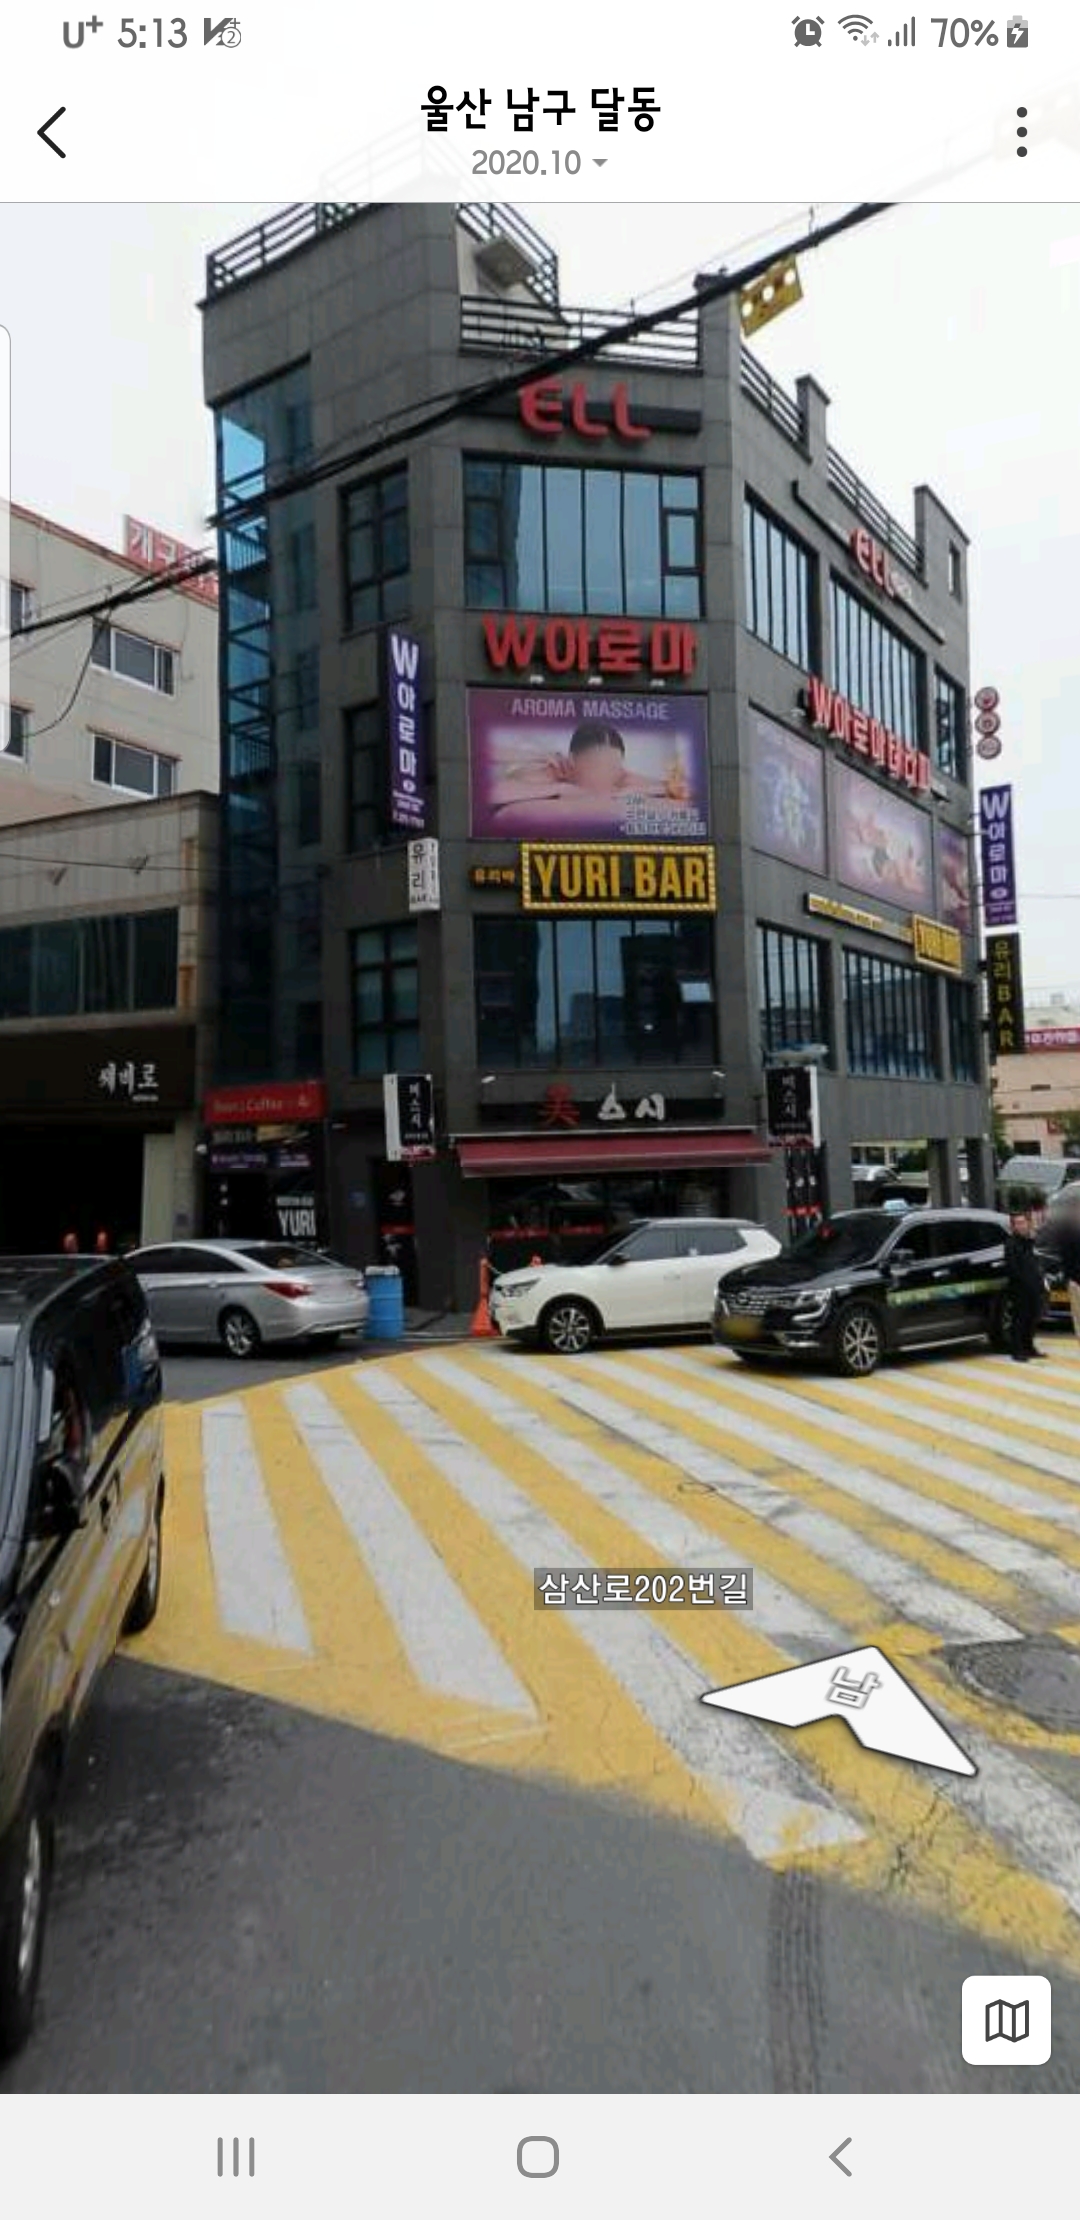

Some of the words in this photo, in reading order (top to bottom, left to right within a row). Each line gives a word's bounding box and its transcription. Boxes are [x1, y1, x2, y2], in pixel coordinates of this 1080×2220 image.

[519, 375, 652, 441] ELL
[482, 613, 697, 677] W아로마
[391, 633, 419, 777] W아로마
[511, 698, 577, 718] AROMA
[582, 700, 671, 720] MASSAGE
[982, 791, 1010, 884] W아로마
[534, 854, 621, 897] YURI
[634, 856, 707, 899] BAR
[278, 1209, 316, 1237] YURI
